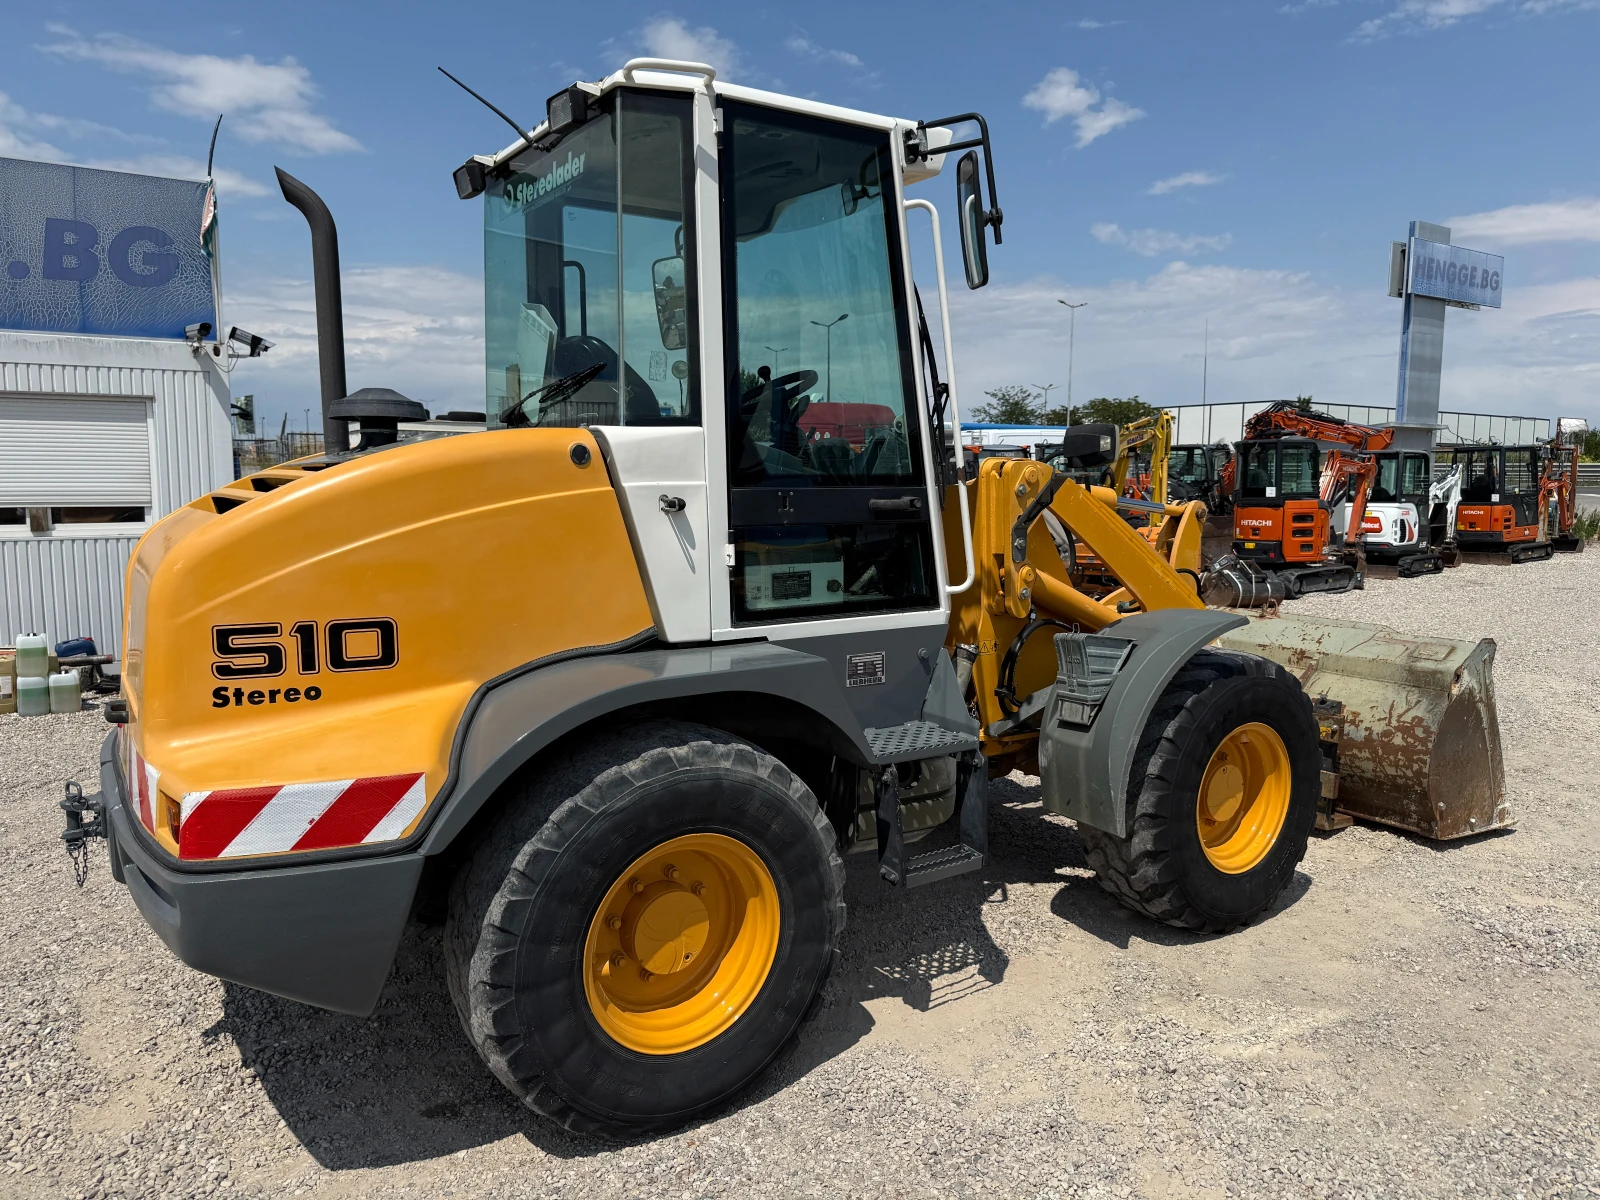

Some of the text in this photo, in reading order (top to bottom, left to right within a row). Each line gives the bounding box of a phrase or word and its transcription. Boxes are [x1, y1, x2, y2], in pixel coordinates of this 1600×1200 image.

[516, 151, 586, 208] Stereolader
[1414, 255, 1500, 292] HENGGE.BG
[1240, 519, 1272, 527] HITACHI
[211, 616, 399, 681] 510
[212, 685, 322, 709] Stereo
